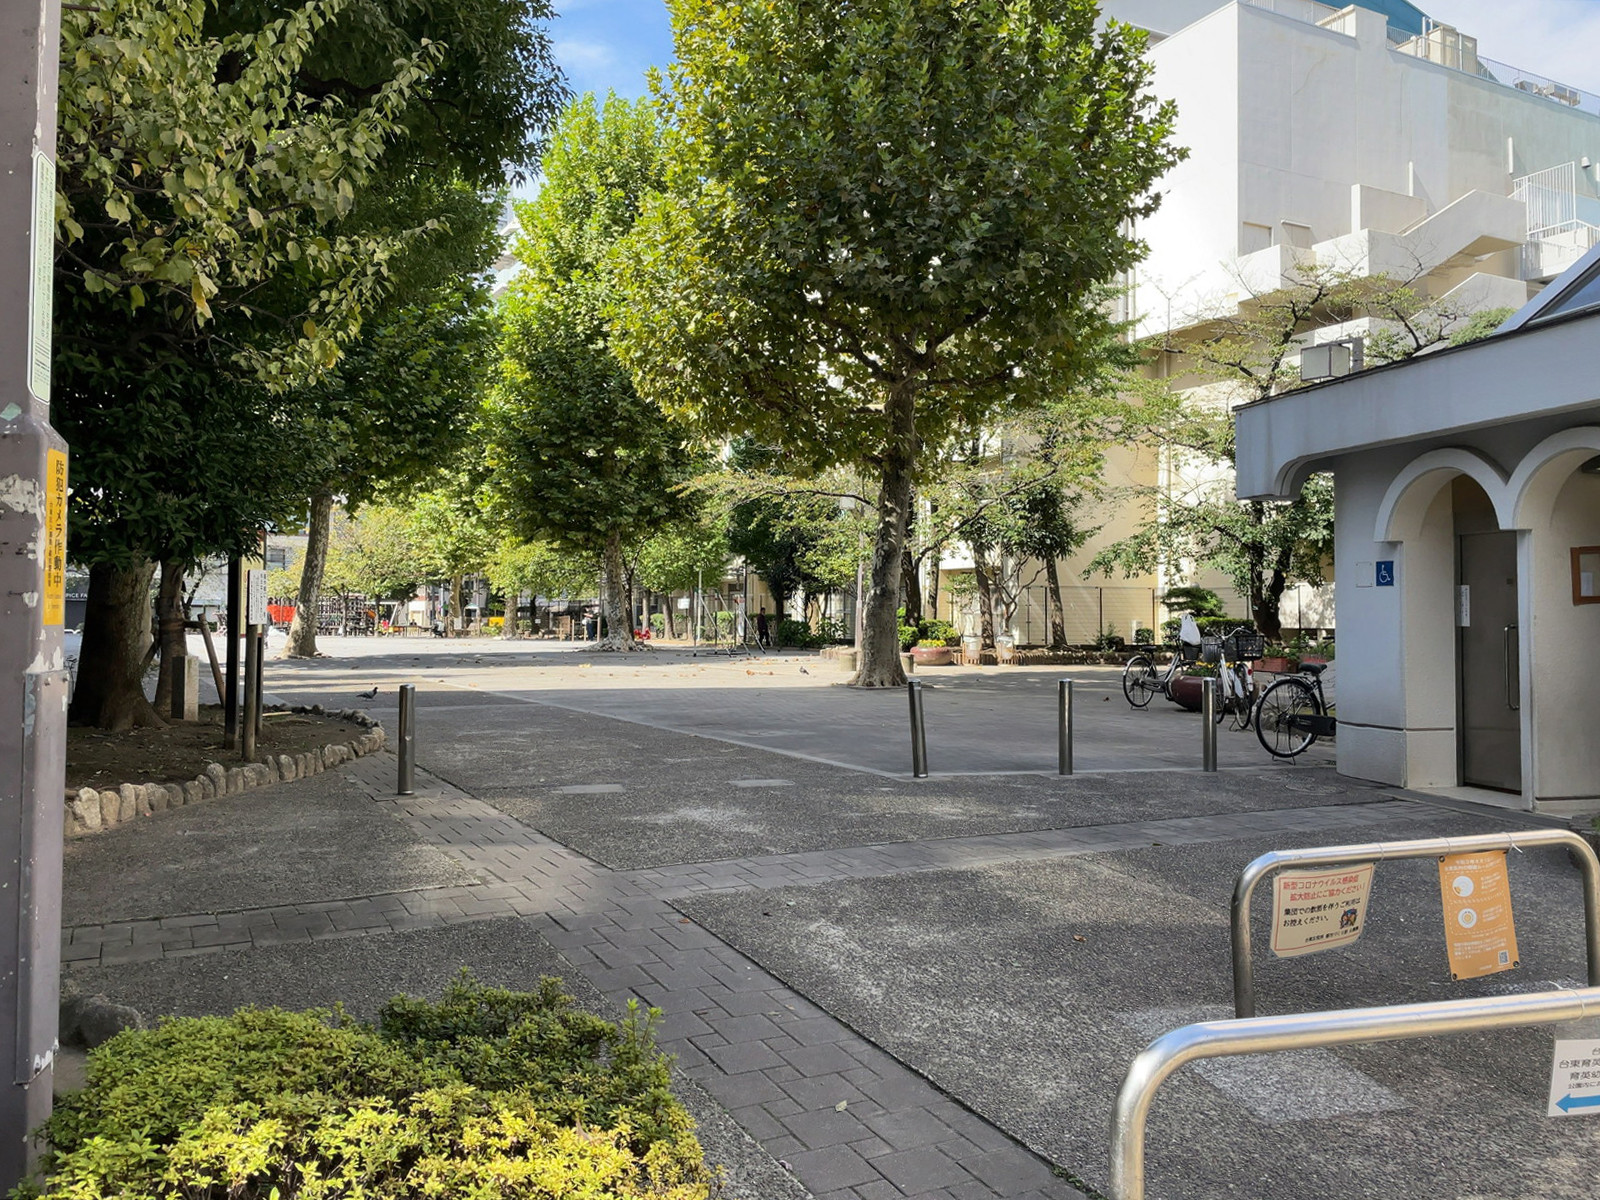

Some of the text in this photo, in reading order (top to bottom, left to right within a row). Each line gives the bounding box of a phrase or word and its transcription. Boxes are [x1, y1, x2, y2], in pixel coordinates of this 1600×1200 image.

[53, 459, 64, 589] 防犯カメラ作動中
